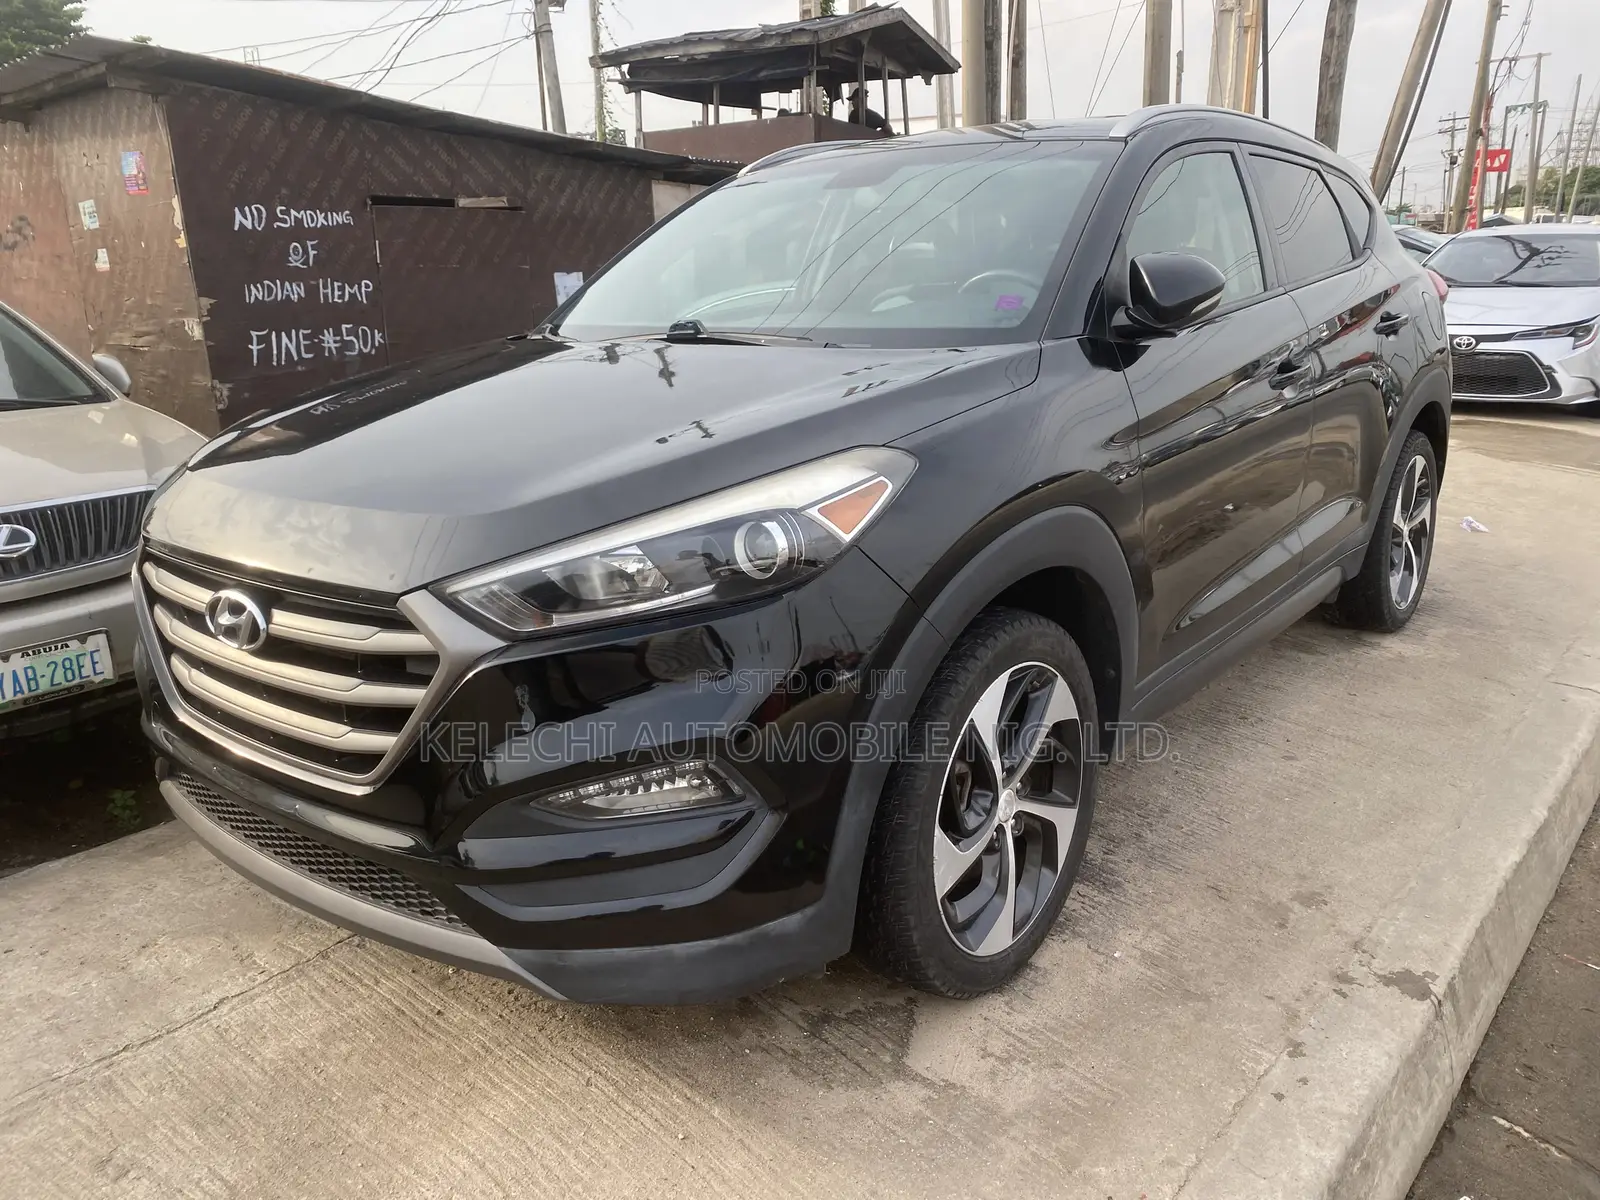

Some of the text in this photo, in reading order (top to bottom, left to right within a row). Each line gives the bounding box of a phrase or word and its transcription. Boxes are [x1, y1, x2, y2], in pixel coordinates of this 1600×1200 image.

[273, 206, 354, 229] SMOKING
[287, 240, 319, 268] OF
[244, 278, 373, 304] INDIAN HEMP
[20, 642, 71, 658] ABUJA
